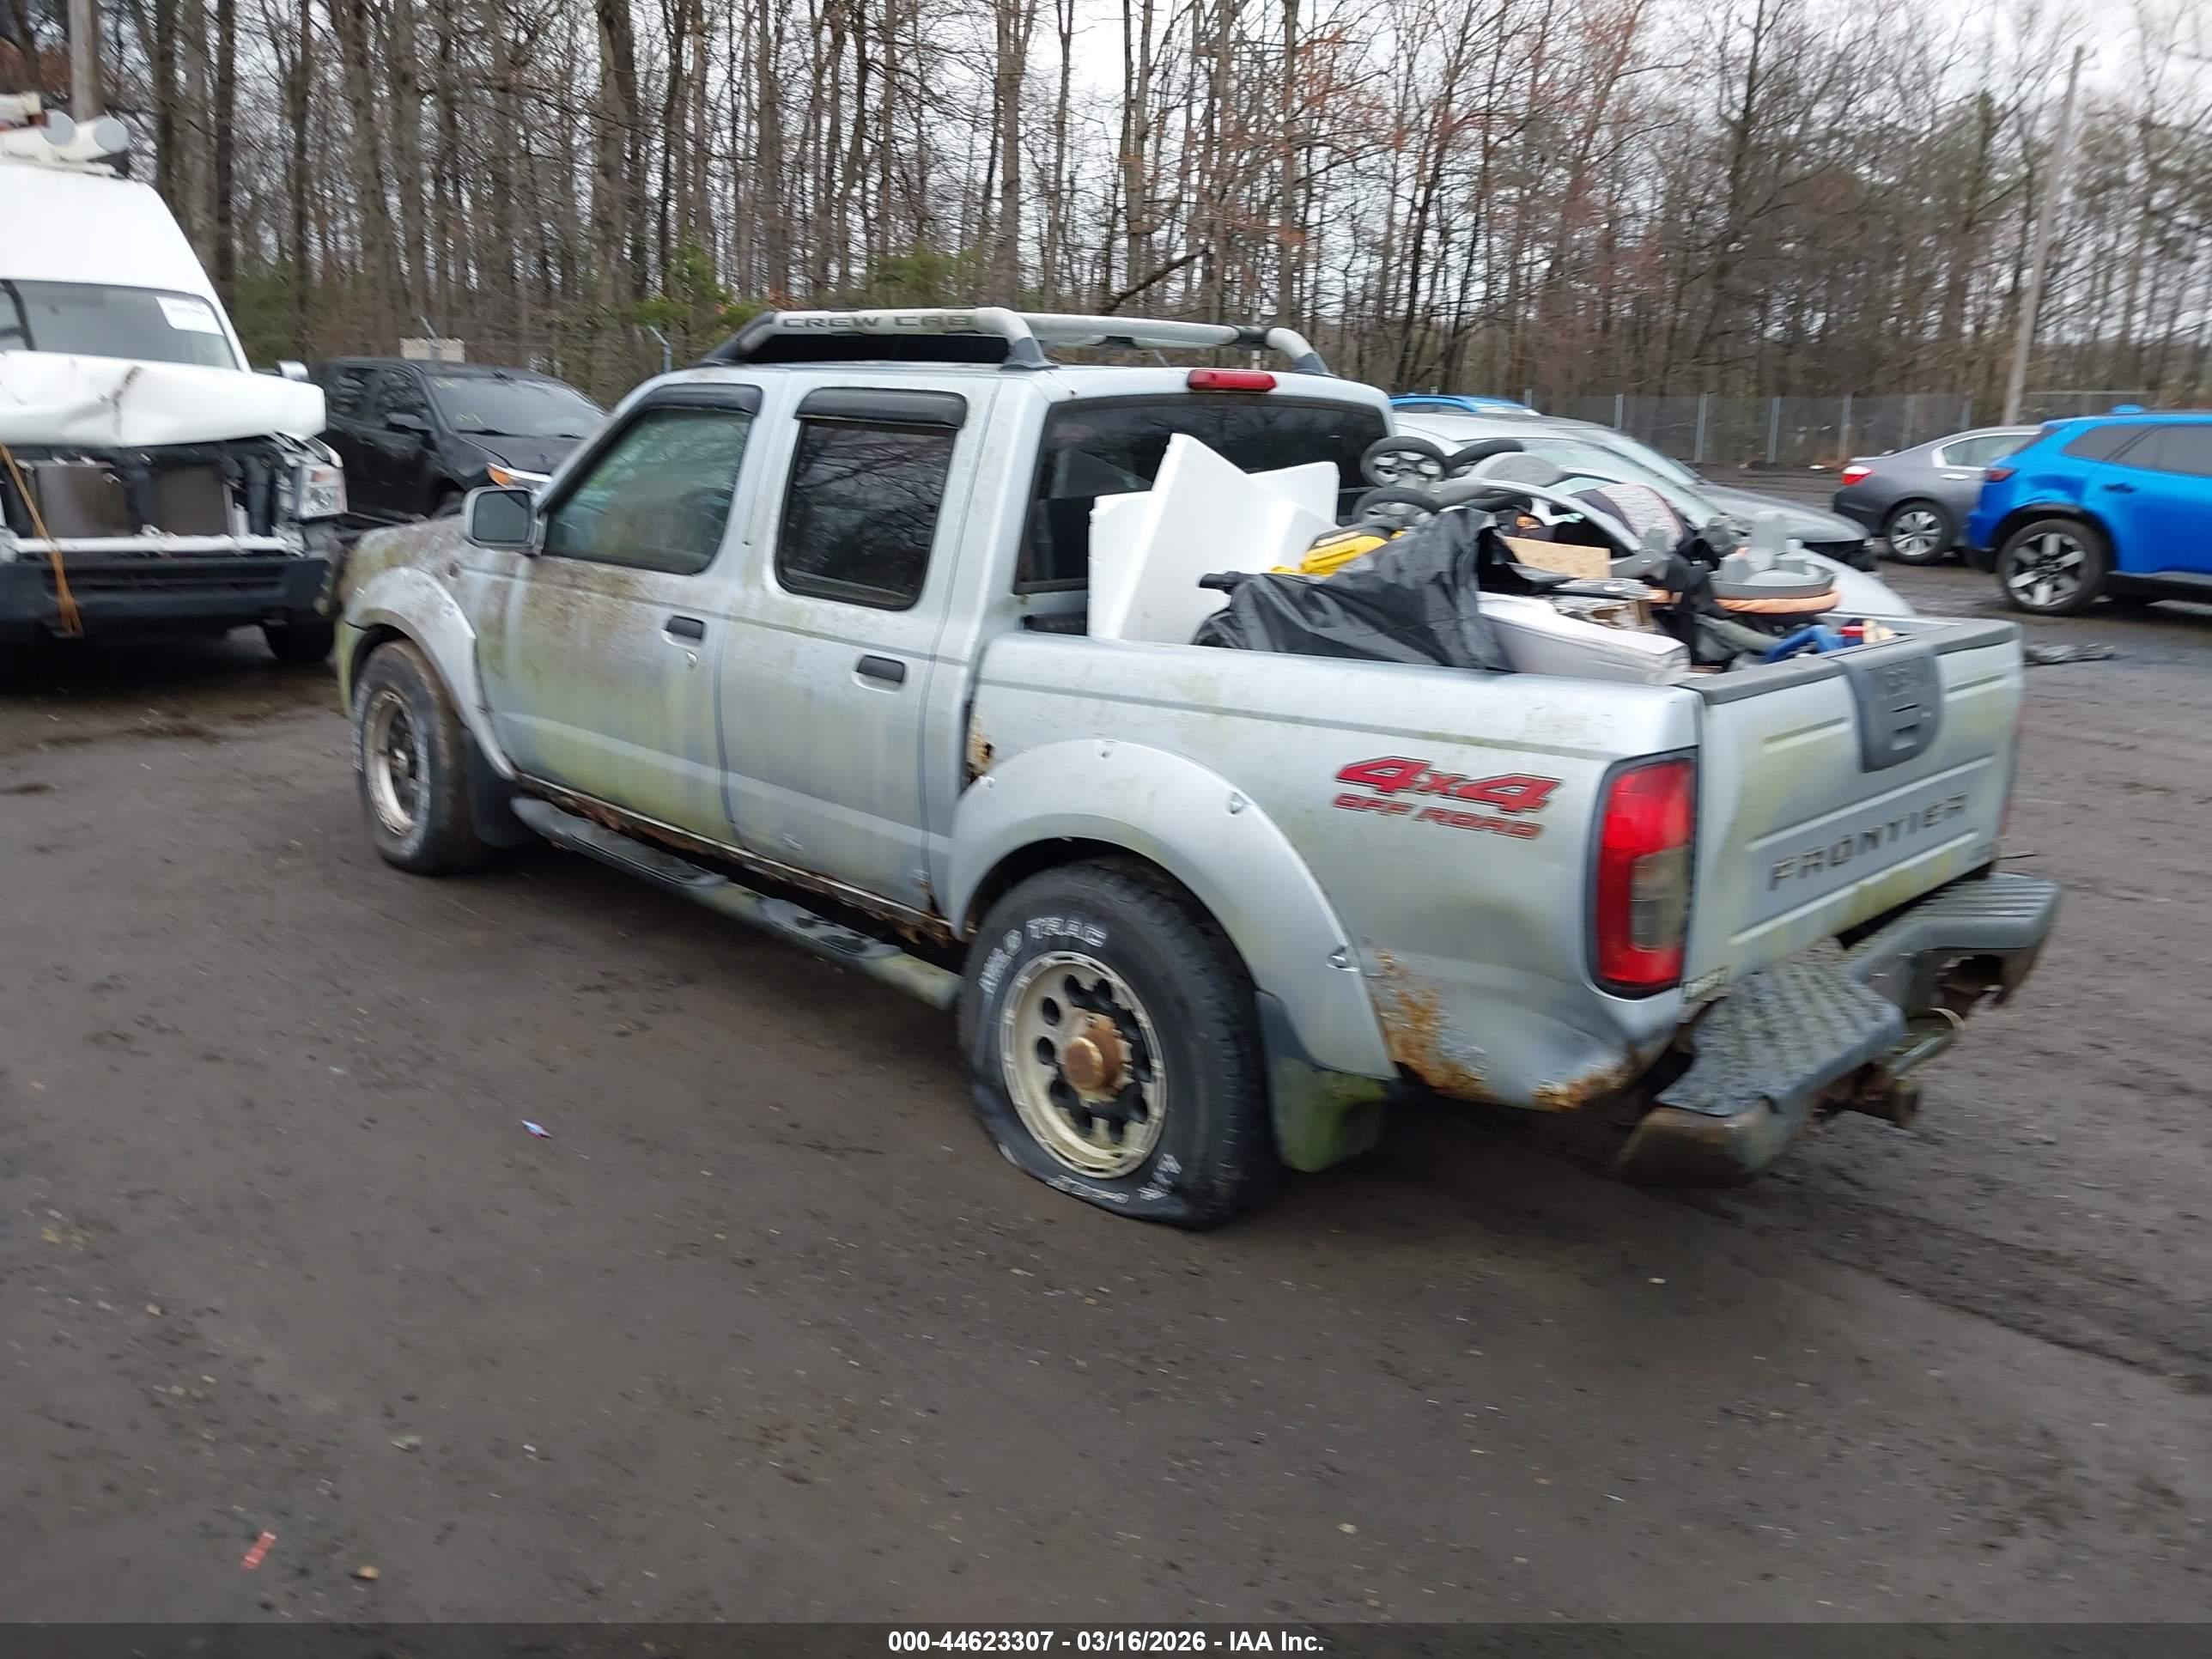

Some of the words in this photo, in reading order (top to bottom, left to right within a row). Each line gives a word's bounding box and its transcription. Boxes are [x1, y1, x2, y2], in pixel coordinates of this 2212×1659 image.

[782, 316, 881, 330] CREW
[894, 315, 972, 328] CAB
[1768, 791, 1969, 891] FRONTIER
